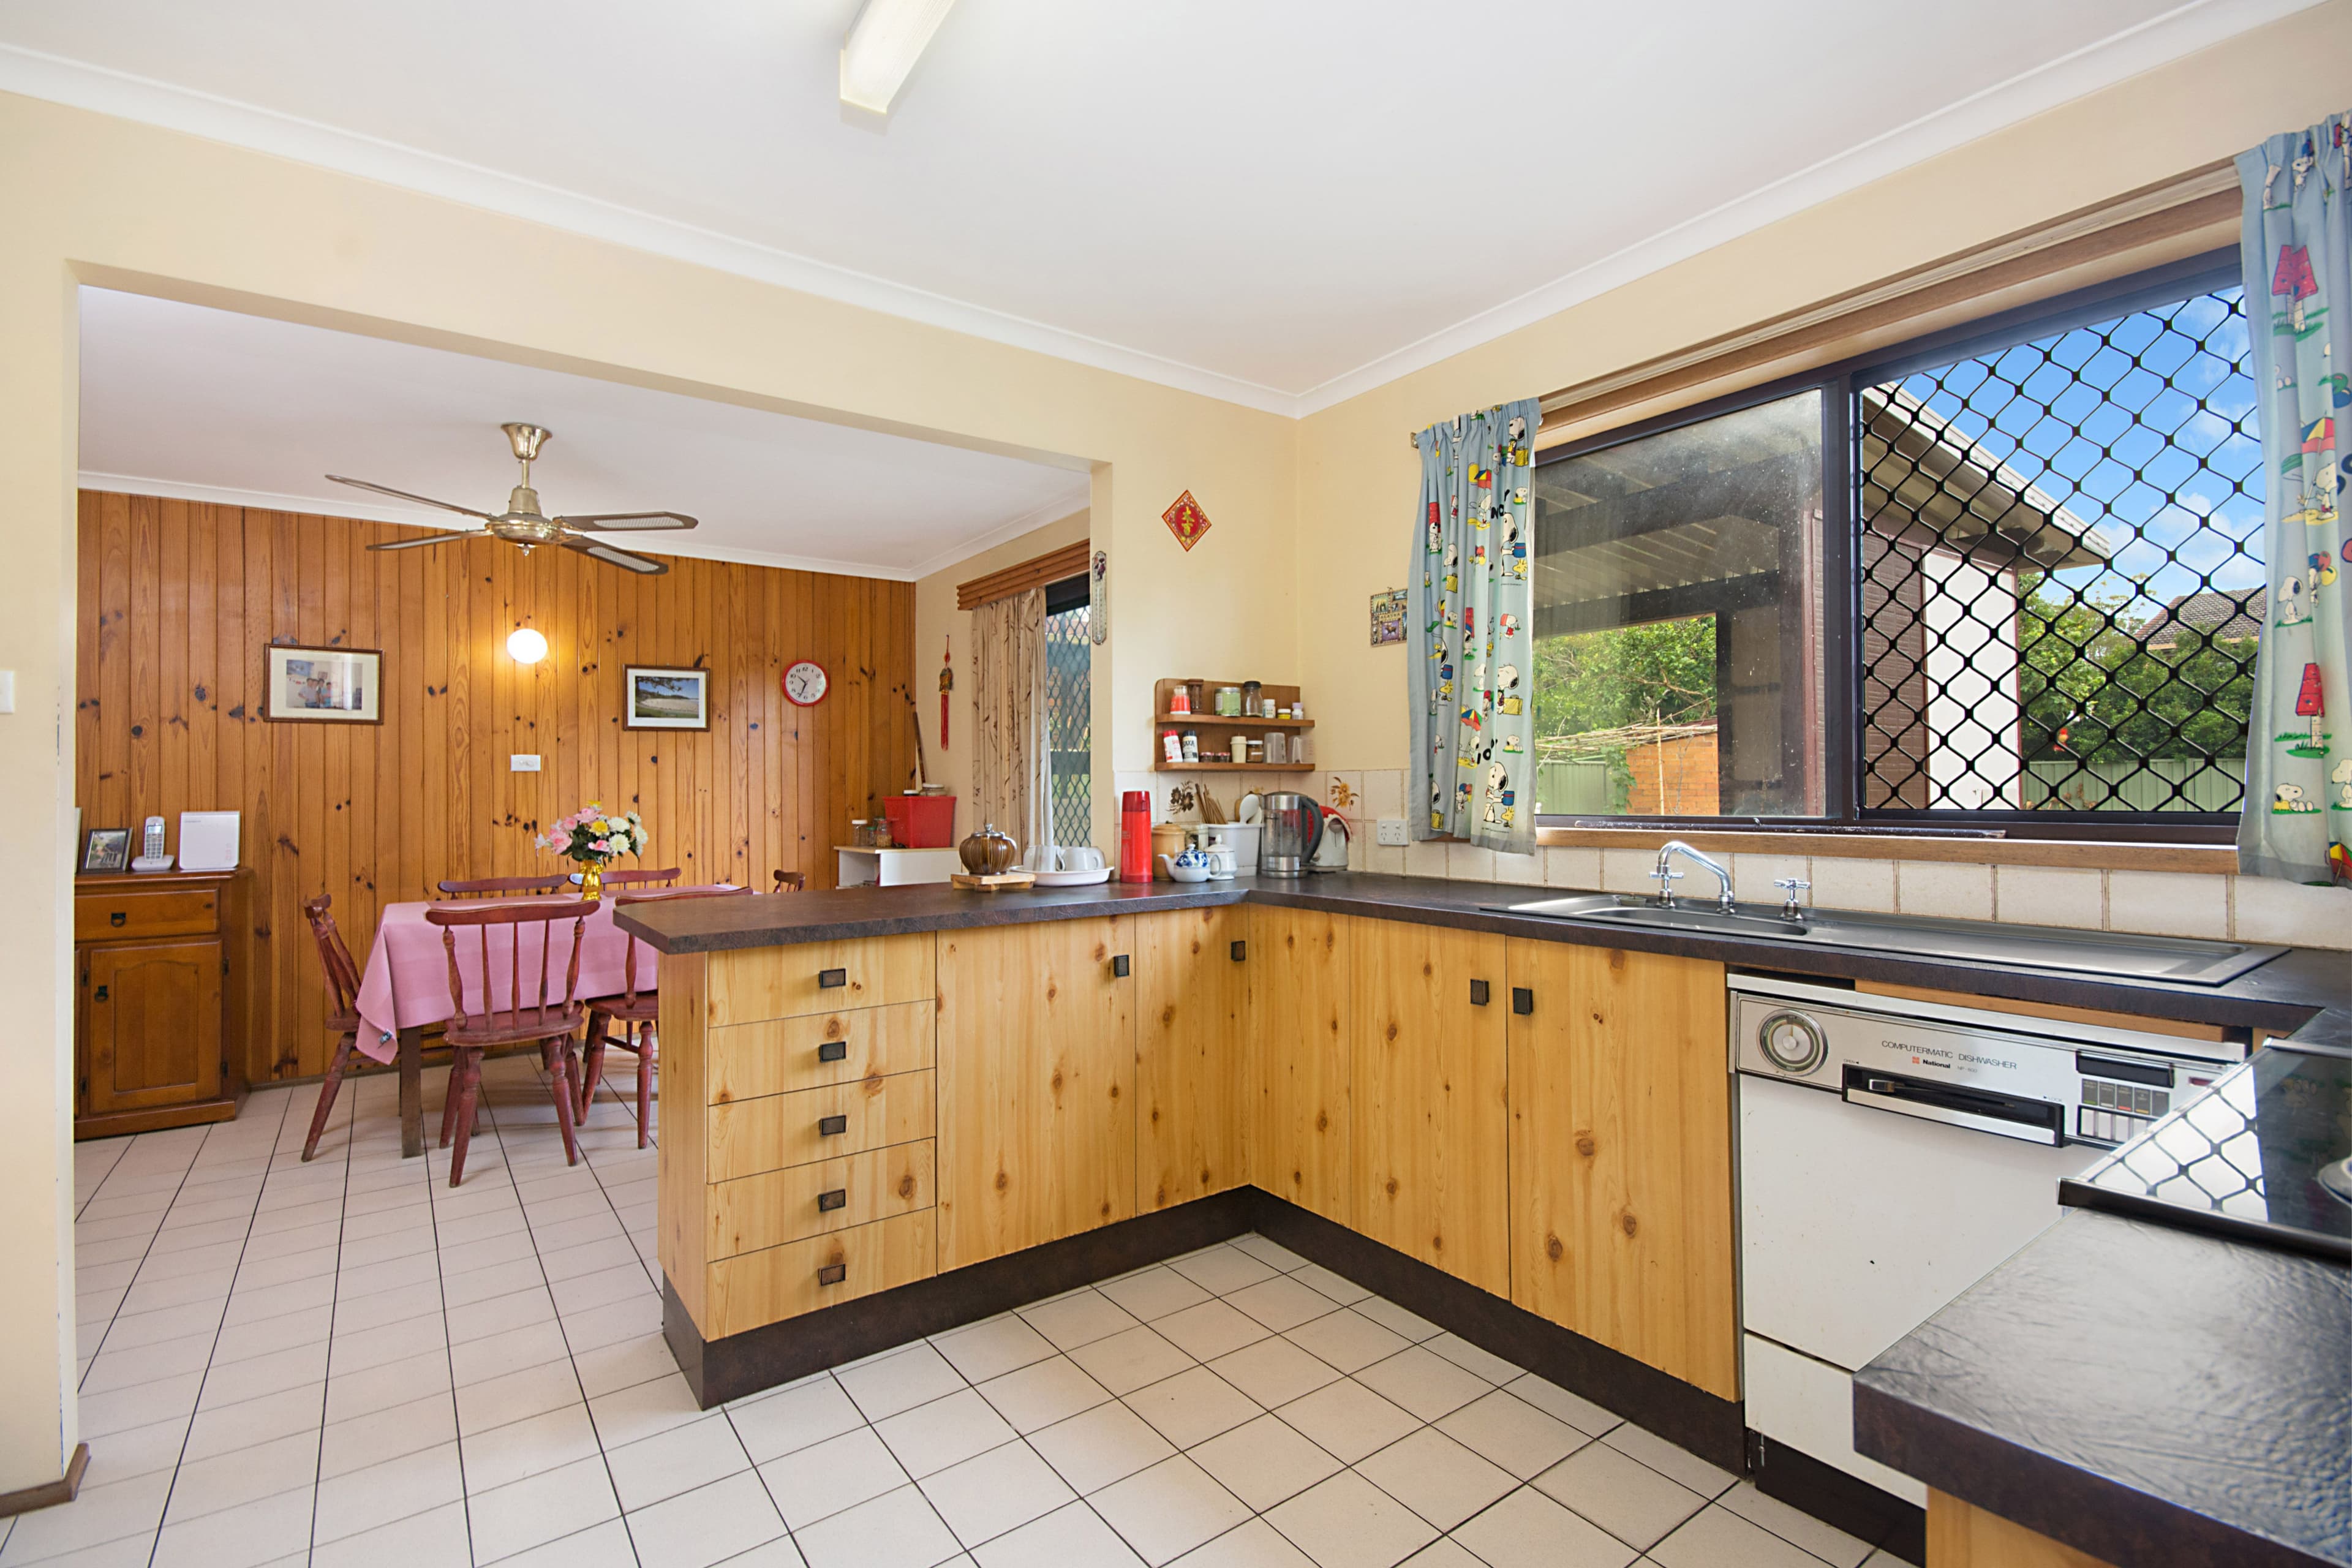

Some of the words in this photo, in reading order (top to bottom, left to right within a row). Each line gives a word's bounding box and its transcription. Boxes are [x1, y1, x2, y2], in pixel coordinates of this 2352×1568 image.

[1882, 1040, 1953, 1059] COMPUTERMATIC
[1958, 1053, 2017, 1070] DISHWASHER
[1923, 1058, 1951, 1069] National
